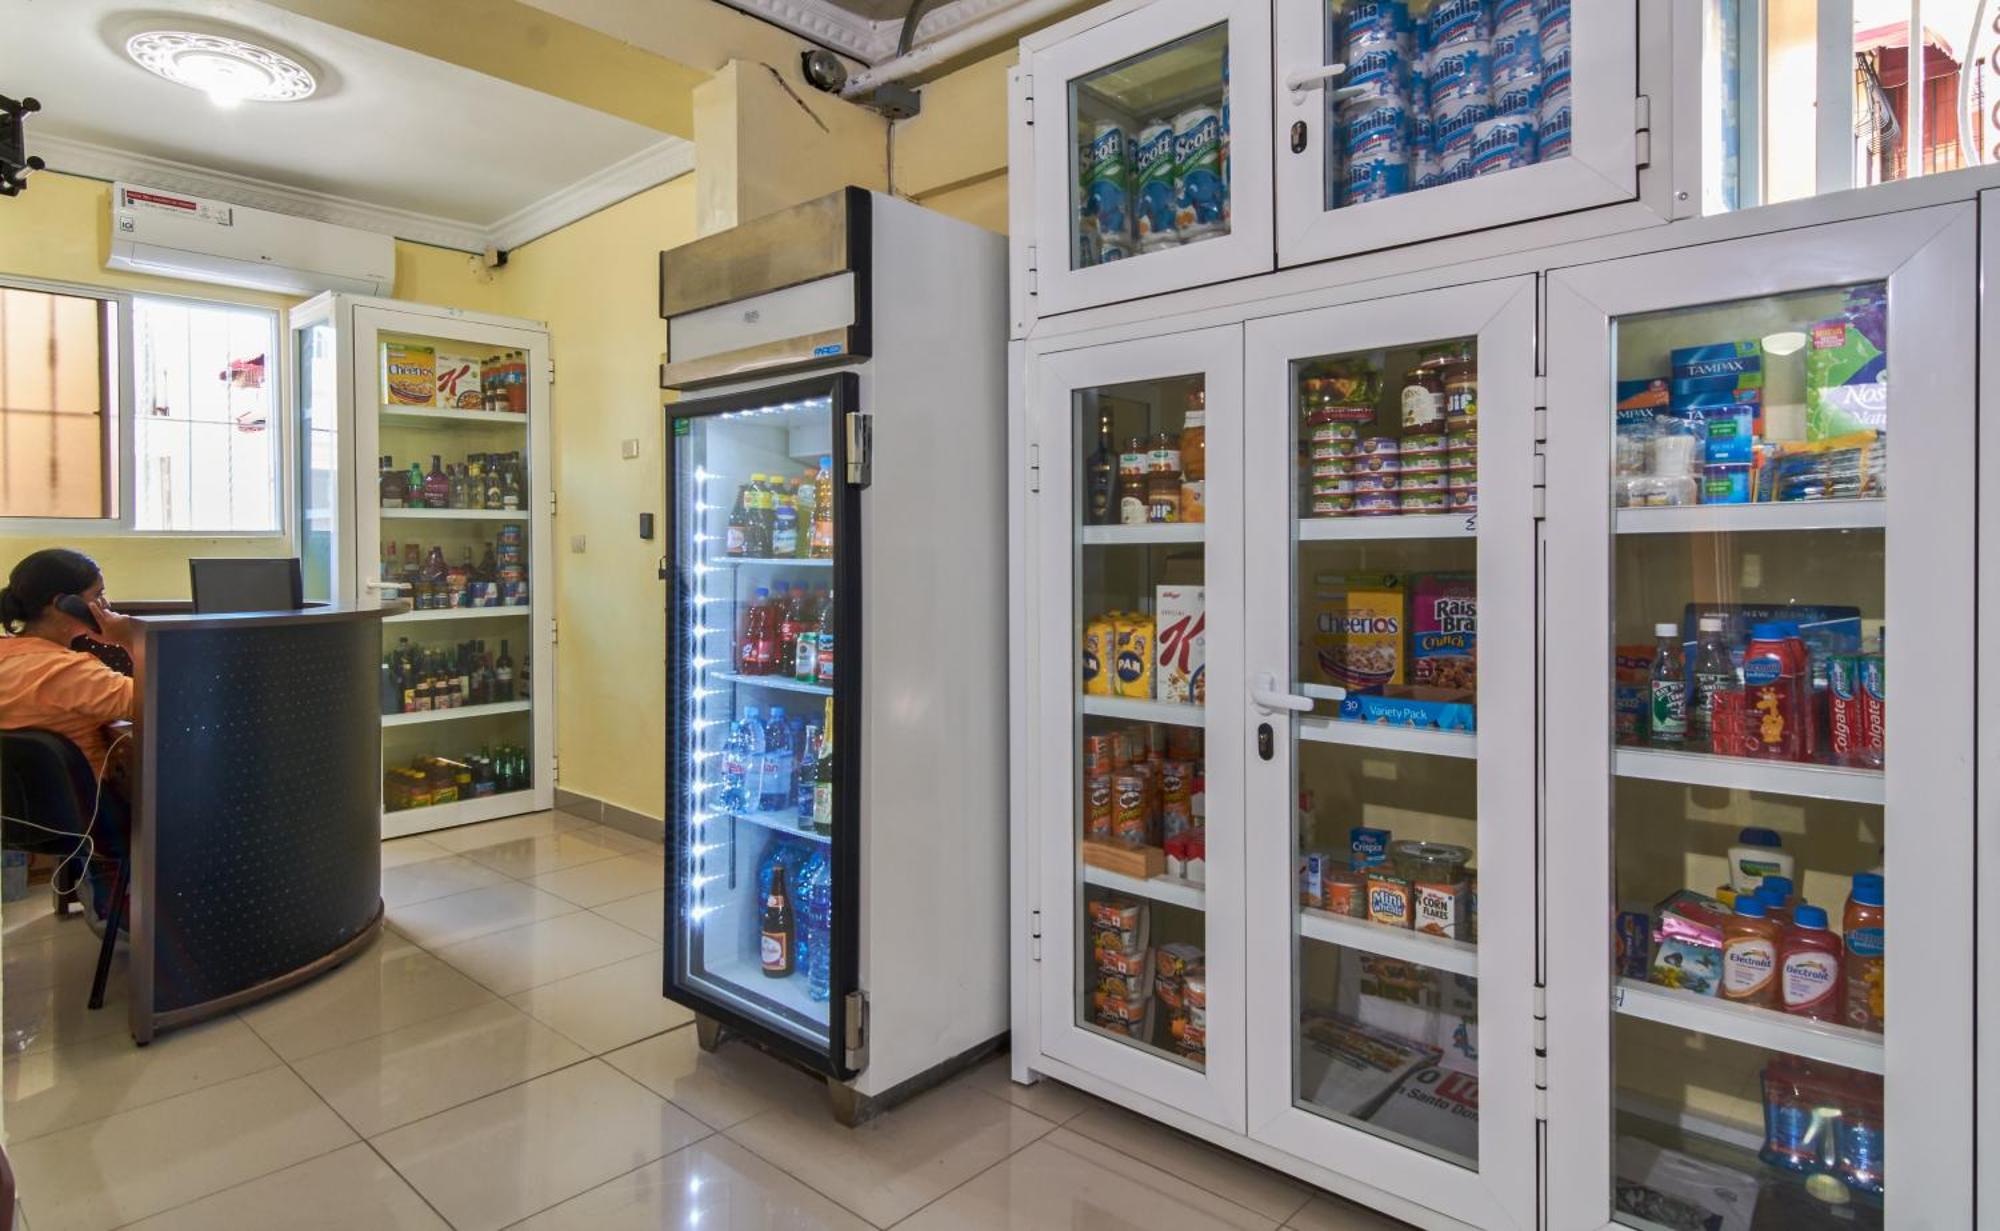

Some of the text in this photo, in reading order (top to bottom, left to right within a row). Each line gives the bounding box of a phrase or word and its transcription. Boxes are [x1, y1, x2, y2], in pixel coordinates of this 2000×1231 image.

[1176, 121, 1217, 165] Scott
[1687, 361, 1743, 376] TAMPAX
[1317, 612, 1398, 634] Cheerios
[1345, 700, 1358, 711] 30
[1369, 704, 1428, 720] Variety Pack
[1834, 699, 1850, 753] Colgate
[1423, 897, 1448, 911] CORN
[1423, 906, 1448, 920] FLAKES
[1407, 1087, 1450, 1110] Santo
